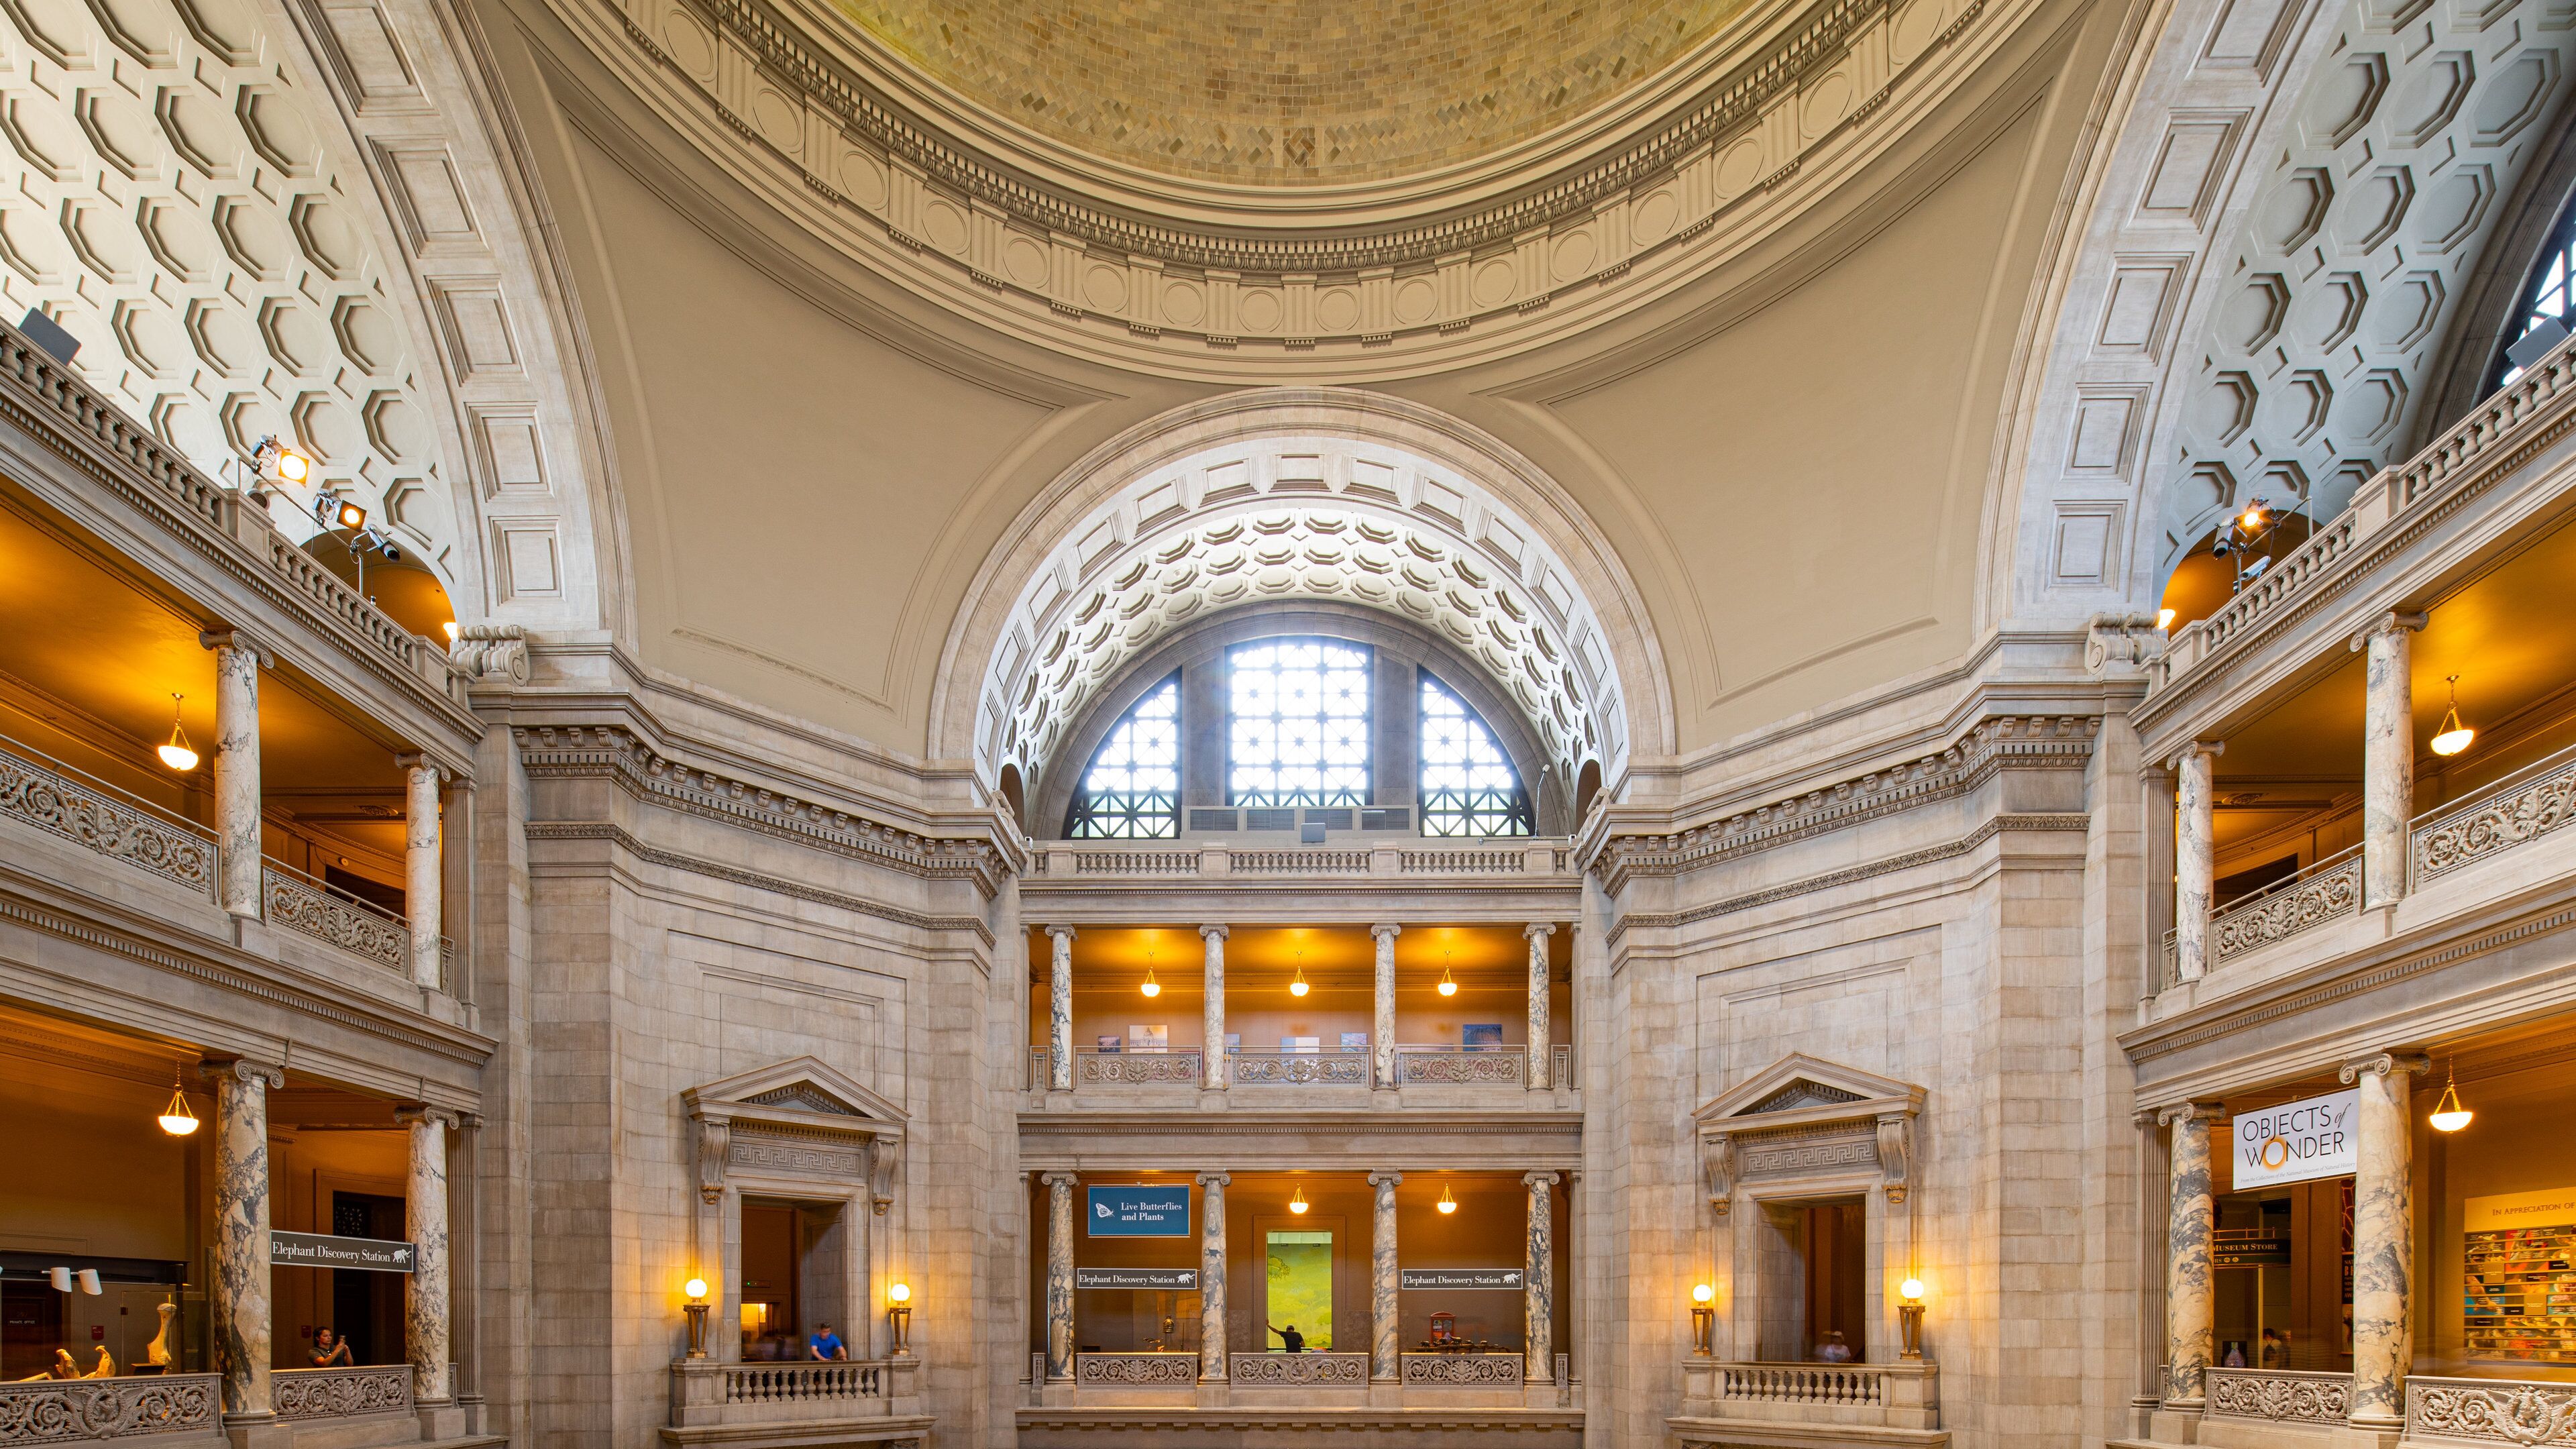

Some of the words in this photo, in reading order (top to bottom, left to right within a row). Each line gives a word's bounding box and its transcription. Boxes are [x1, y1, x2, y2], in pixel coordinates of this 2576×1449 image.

[2243, 1105, 2331, 1142] OBJECTS
[2334, 1102, 2351, 1128] of
[2245, 1131, 2344, 1168] WONDER
[1121, 1202, 1138, 1211] Live
[1140, 1202, 1182, 1211] Butterflies
[1122, 1213, 1137, 1221] and
[1138, 1212, 1164, 1221] Plants
[272, 1241, 315, 1259] Elephant
[317, 1245, 360, 1263] Discovery
[362, 1249, 390, 1263] Station
[1079, 1275, 1112, 1285] Elephant
[1113, 1275, 1148, 1285] Discovery
[1149, 1275, 1175, 1284] Station
[1403, 1275, 1436, 1286] Elephant
[1438, 1275, 1473, 1286] Discovery
[1474, 1275, 1501, 1284] Station
